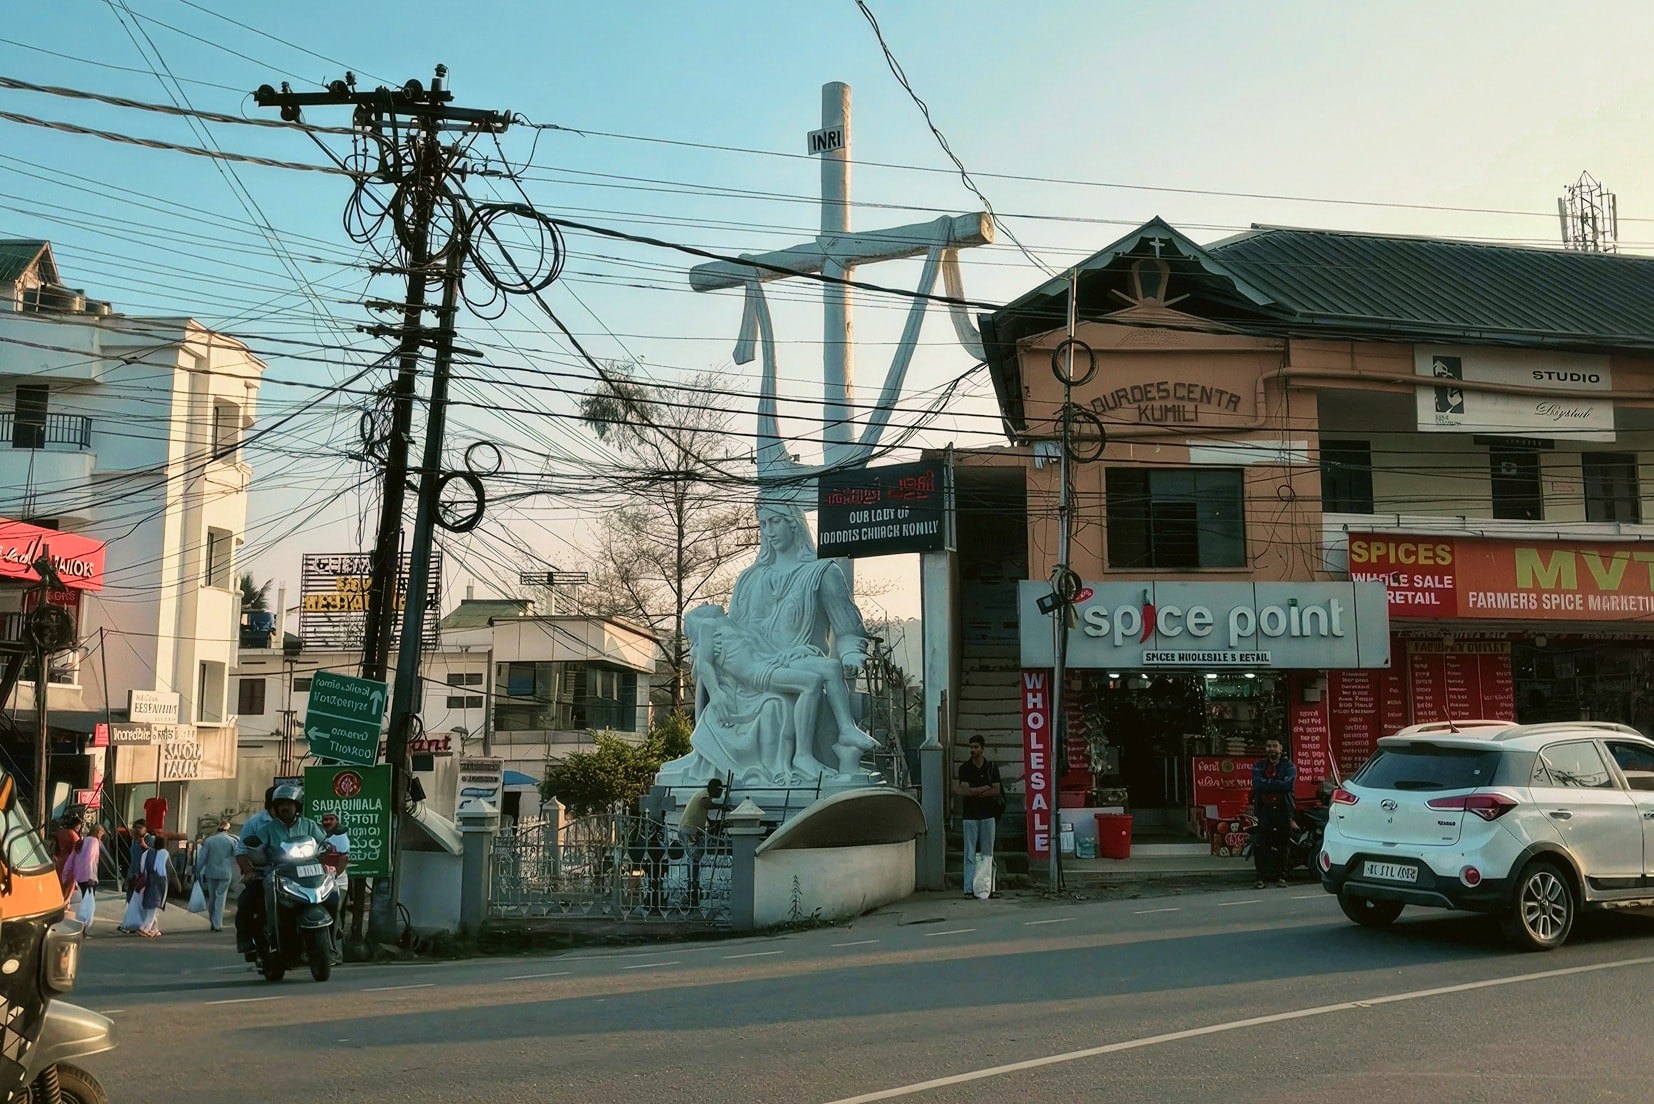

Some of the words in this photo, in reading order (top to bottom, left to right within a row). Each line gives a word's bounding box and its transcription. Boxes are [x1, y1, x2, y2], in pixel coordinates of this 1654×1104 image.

[812, 130, 841, 151] INRI
[1532, 370, 1600, 384] STUDIO
[1138, 404, 1199, 423] KUMILI
[849, 510, 870, 524] OUR
[1351, 540, 1453, 566] SPICES
[1413, 574, 1453, 588] SALE
[1386, 590, 1440, 605] RETAIL
[1468, 591, 1538, 610] FARMERS
[1541, 593, 1584, 611] SPICE
[1588, 594, 1654, 612] MARKETI
[1228, 598, 1345, 648] point
[1023, 672, 1050, 852] WHOLESALE
